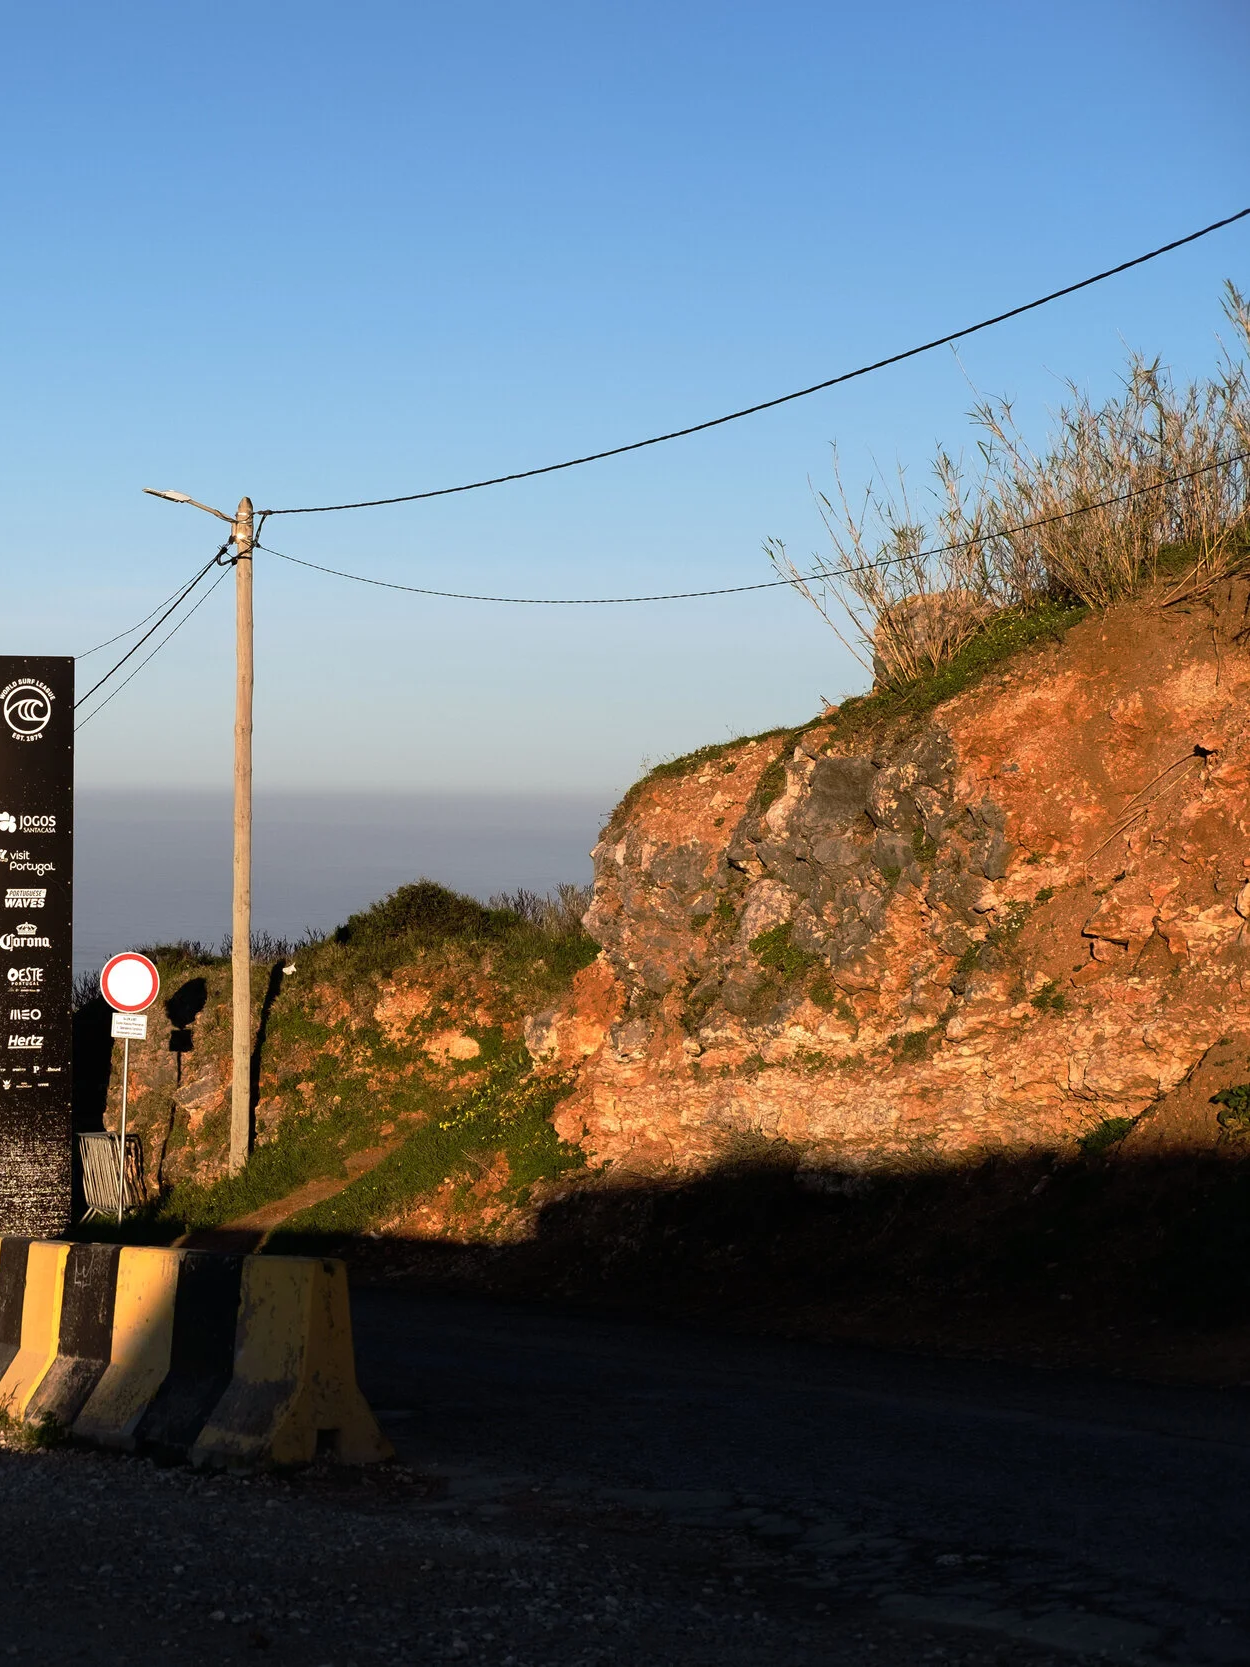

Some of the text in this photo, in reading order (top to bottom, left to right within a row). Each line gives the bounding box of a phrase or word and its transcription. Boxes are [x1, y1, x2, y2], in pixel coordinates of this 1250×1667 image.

[36, 680, 56, 700] LEAGUE
[12, 732, 25, 741] EST.
[19, 815, 56, 830] JOGOS
[10, 850, 30, 860] visit
[10, 861, 56, 876] Portugal
[5, 898, 45, 908] WAVES
[0, 933, 50, 952] Corona
[7, 967, 44, 982] OESTE
[10, 1009, 41, 1020] MEO
[8, 1034, 44, 1046] Hertz
